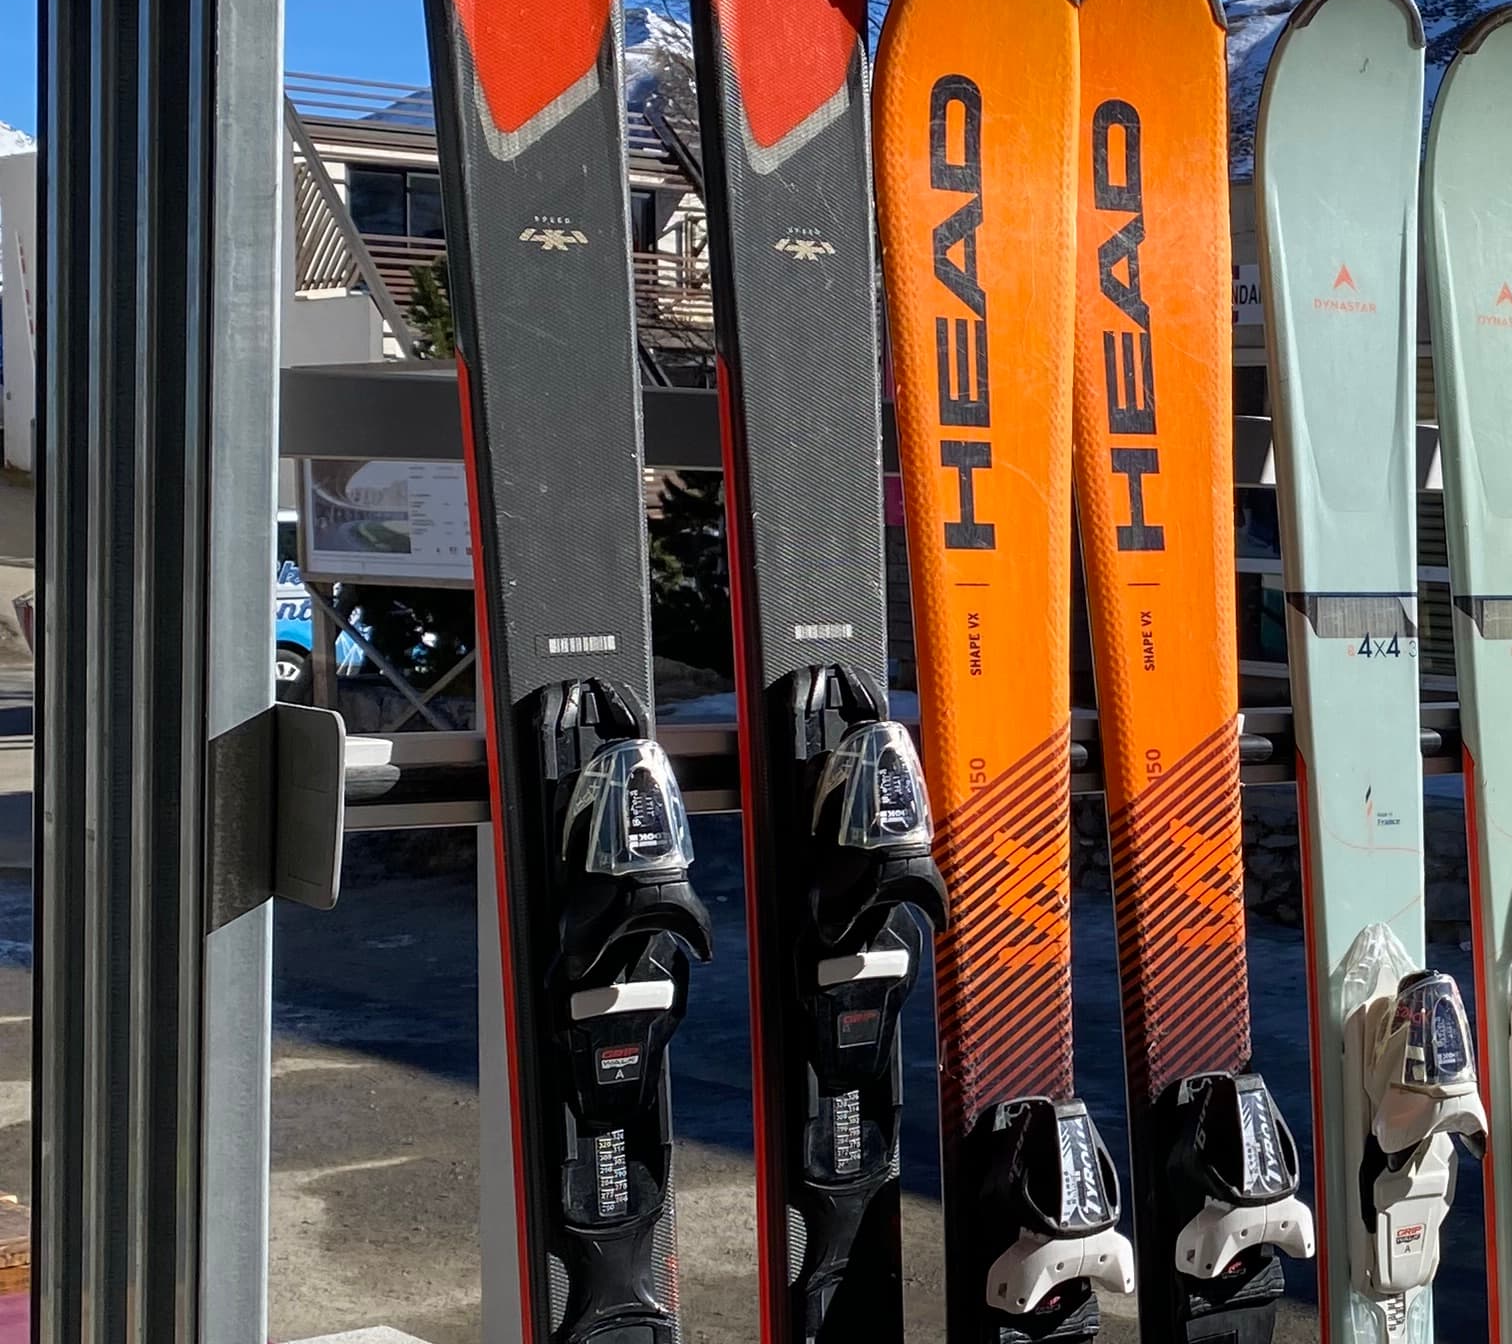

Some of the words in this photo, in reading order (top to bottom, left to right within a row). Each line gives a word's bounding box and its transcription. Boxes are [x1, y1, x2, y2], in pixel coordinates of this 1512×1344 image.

[929, 74, 996, 550] HEAD
[1313, 298, 1376, 314] DYNASTAR
[1092, 99, 1165, 552] HEAD
[967, 611, 981, 630] VX
[1140, 609, 1154, 629] VX
[969, 632, 982, 677] SHAPE
[1142, 632, 1156, 673] SHAPE
[602, 1047, 639, 1059] GRIP
[614, 1069, 625, 1079] A
